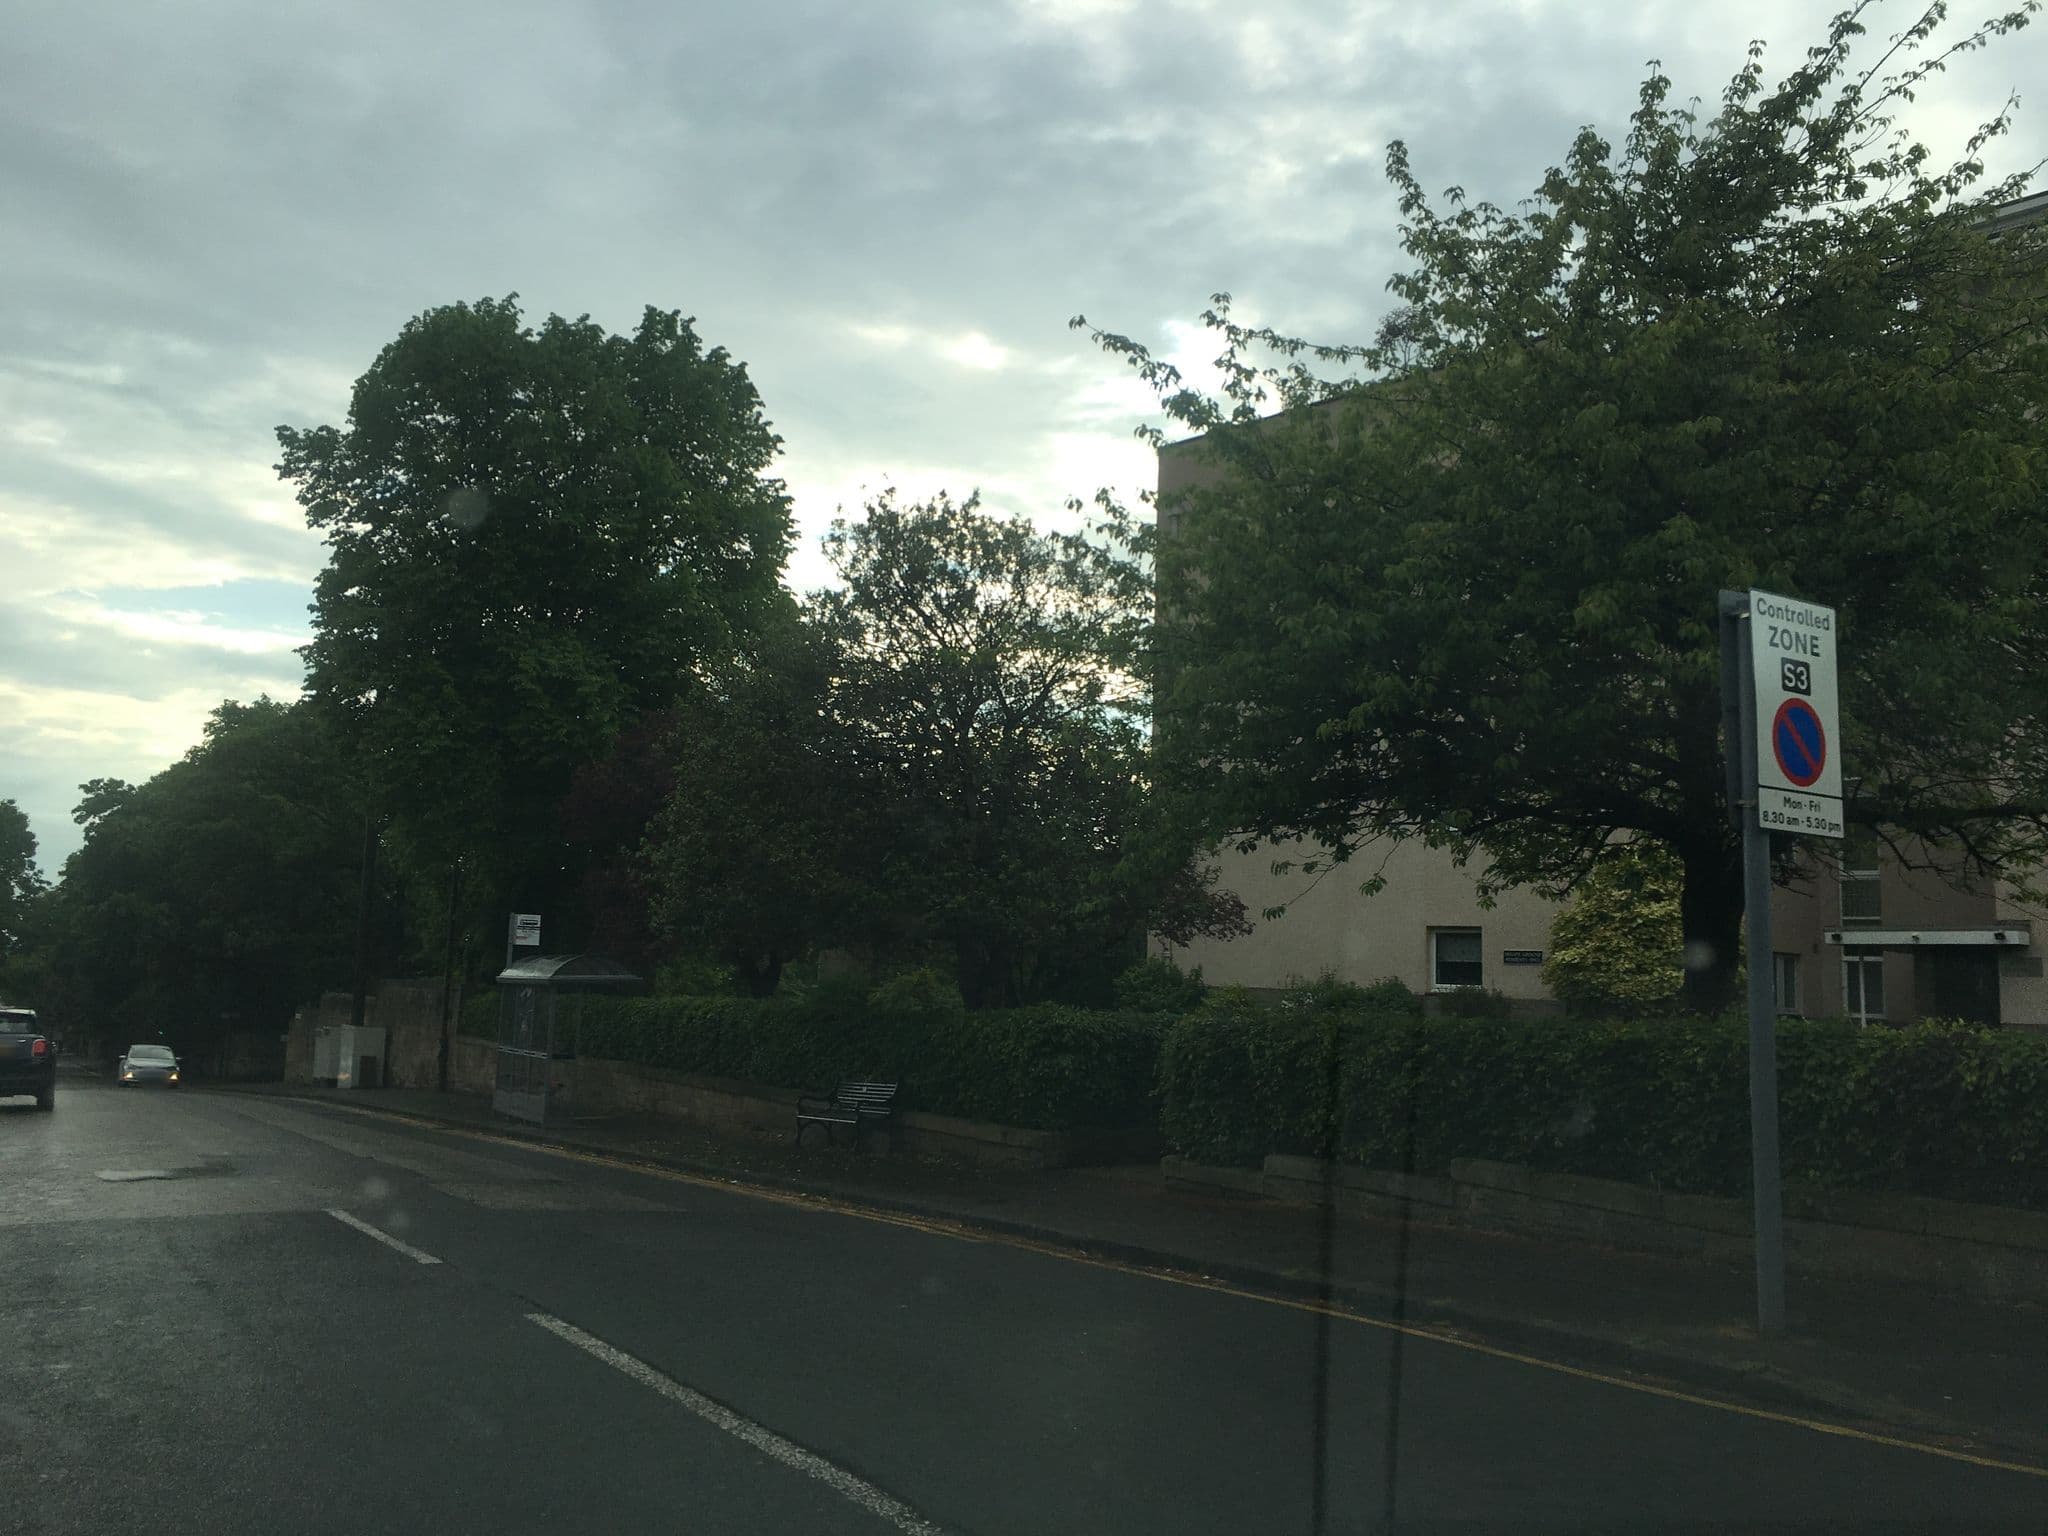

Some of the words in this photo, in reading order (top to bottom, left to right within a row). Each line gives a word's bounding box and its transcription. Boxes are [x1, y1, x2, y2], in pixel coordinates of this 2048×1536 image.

[1757, 598, 1830, 631] Controlled
[1768, 626, 1821, 657] ZONE
[1784, 663, 1809, 690] S3
[1784, 796, 1803, 810] Mon
[1809, 800, 1821, 812] Fri
[1762, 811, 1785, 824] 8.30
[1785, 816, 1800, 826] am
[1806, 817, 1827, 831] 5.30
[1828, 822, 1841, 833] pm
